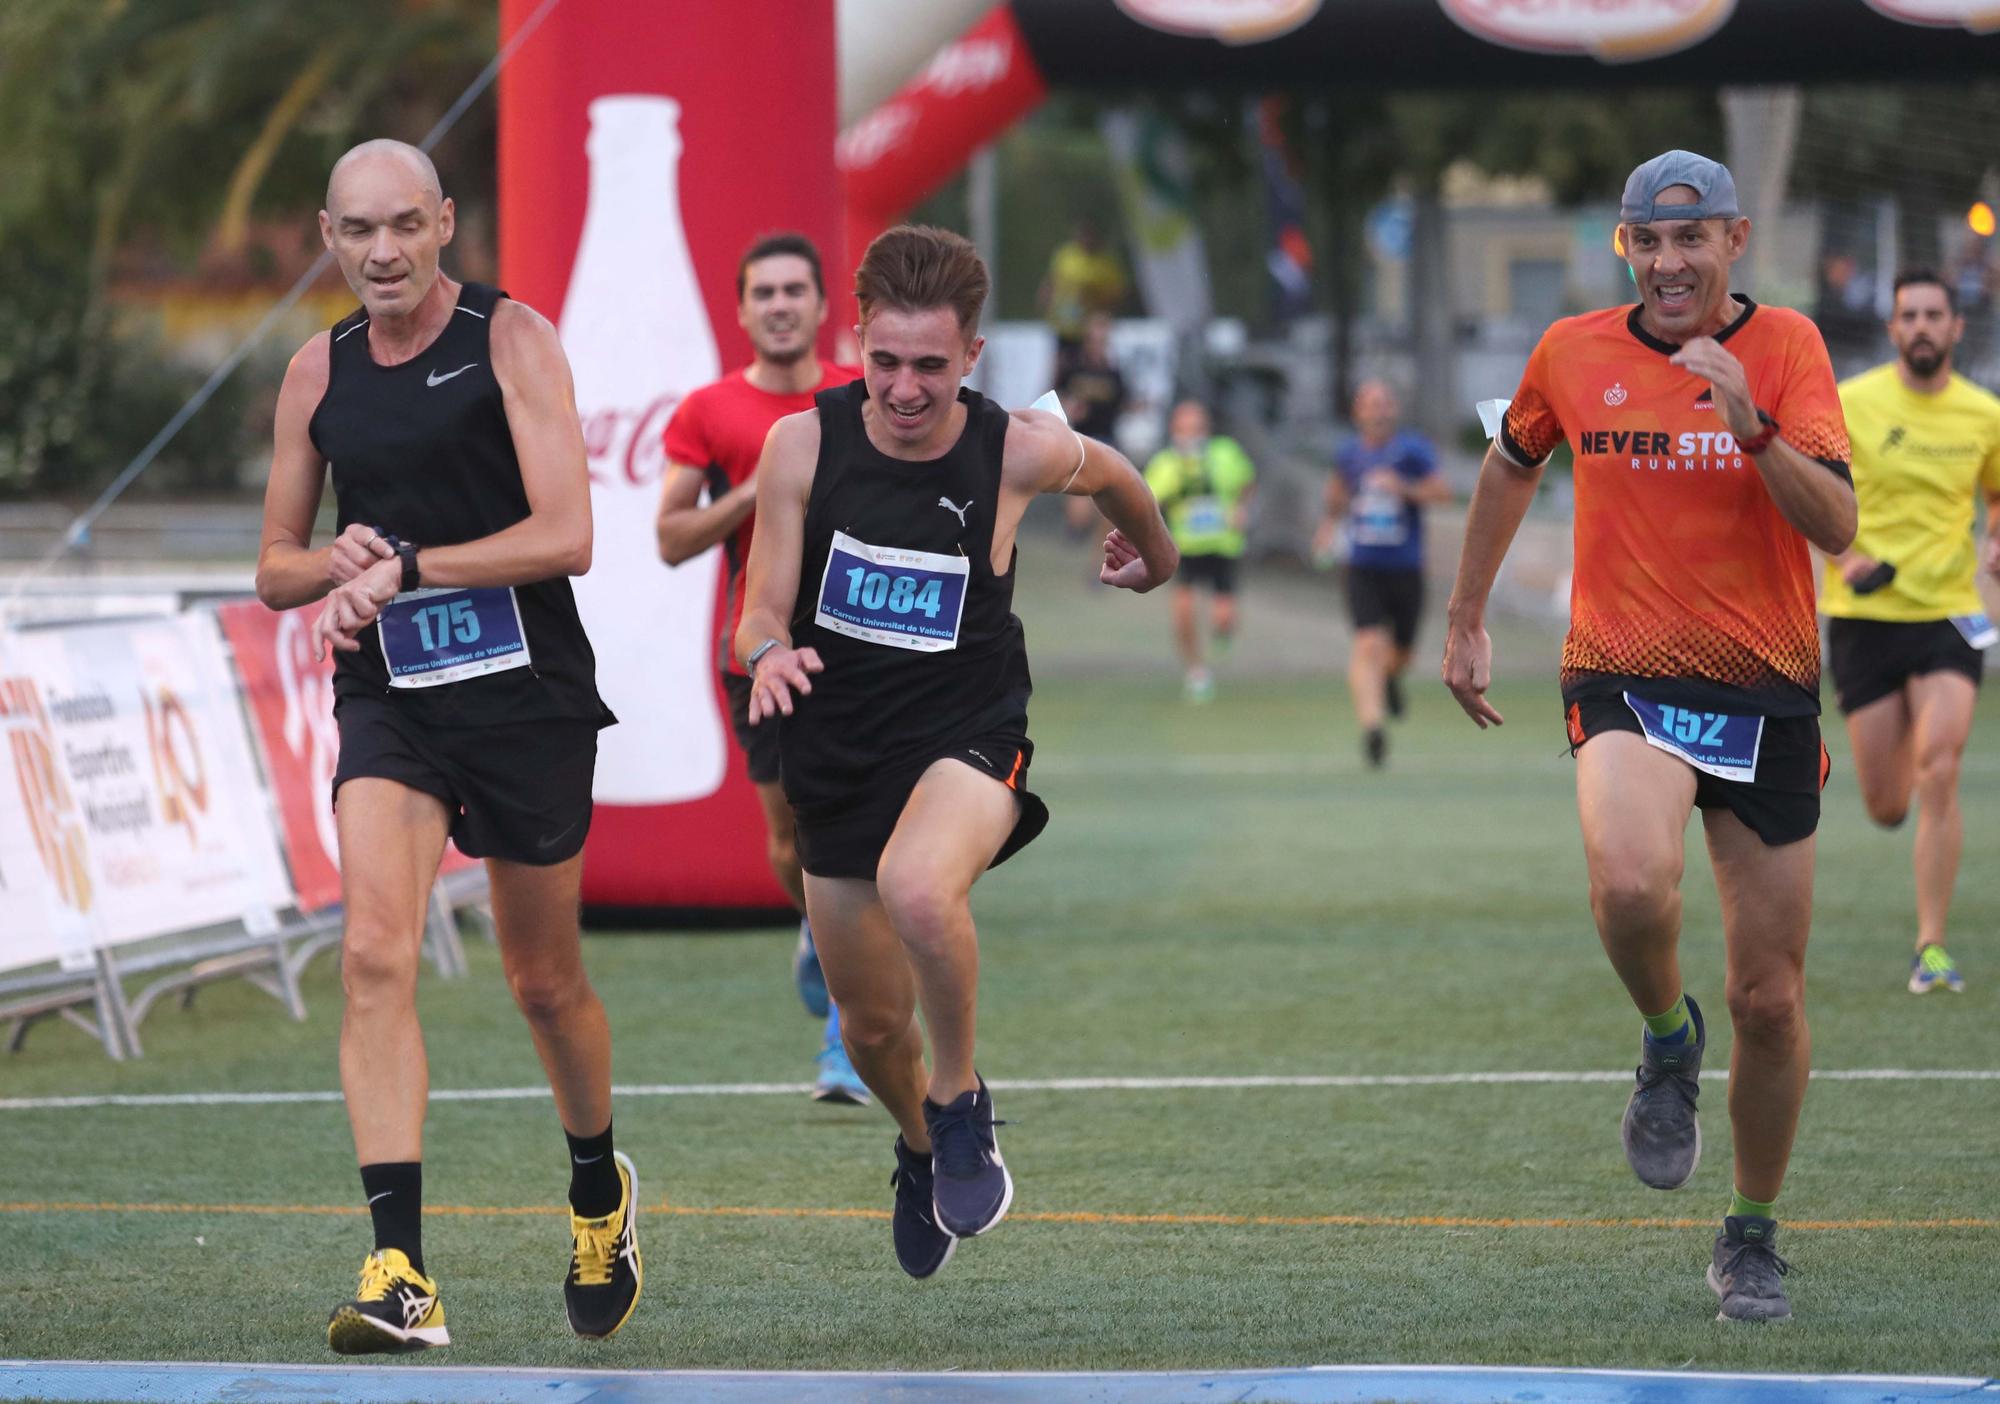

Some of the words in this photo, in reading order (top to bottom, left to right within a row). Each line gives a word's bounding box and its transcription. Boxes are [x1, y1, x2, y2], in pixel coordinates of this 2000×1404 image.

[1581, 431, 1671, 456] NEVER
[1677, 431, 1741, 456] STO
[1631, 459, 1743, 470] RUNNING
[846, 567, 943, 619] 1084
[411, 599, 481, 652] 175
[822, 604, 831, 613] IX
[832, 608, 861, 623] Carrera
[862, 618, 906, 631] Universitat
[907, 624, 917, 633] de
[919, 626, 953, 638] València
[402, 663, 429, 673] Carrera
[430, 653, 473, 667] Universitat
[1658, 704, 1729, 747] 152
[1706, 755, 1717, 763] de
